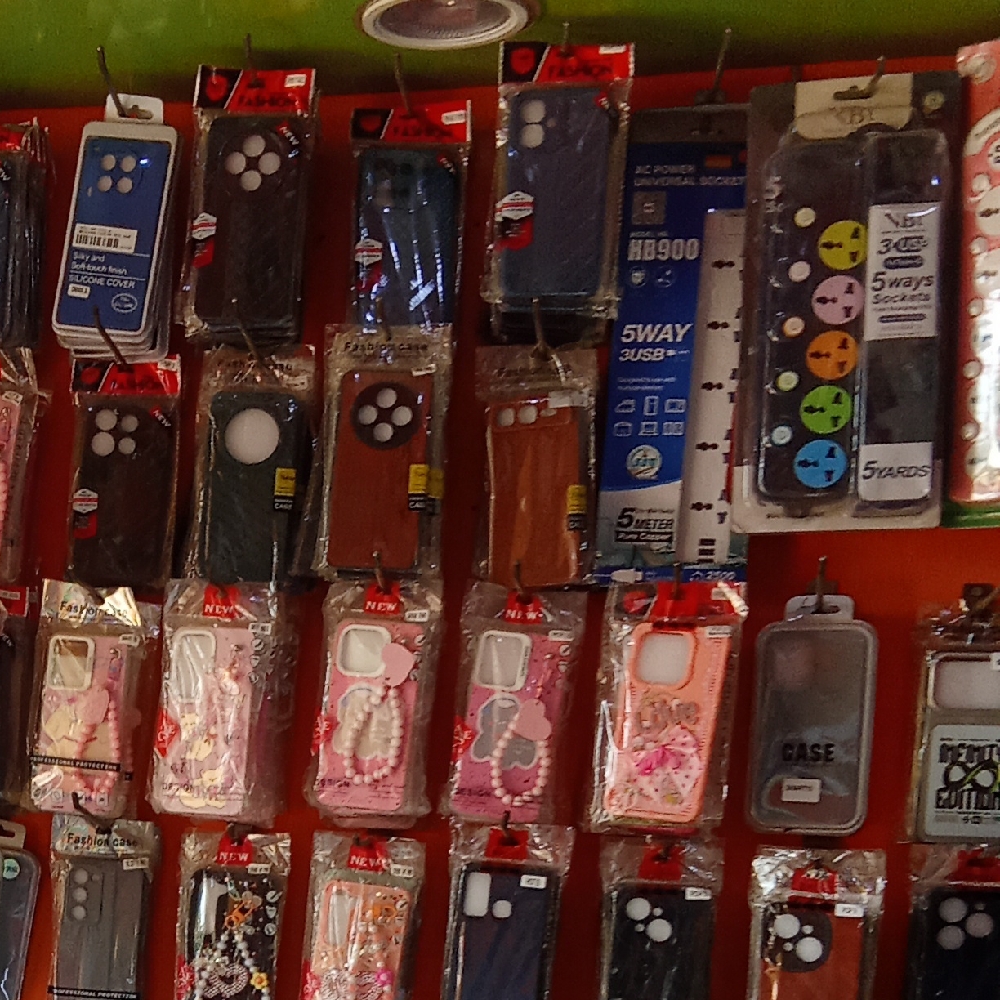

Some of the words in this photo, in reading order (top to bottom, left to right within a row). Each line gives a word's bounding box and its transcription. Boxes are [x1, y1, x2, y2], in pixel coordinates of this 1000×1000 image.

[106, 280, 136, 289] COVER
[621, 323, 694, 343] 5WAY
[617, 507, 636, 529] 5
[203, 603, 235, 615] NEW
[364, 601, 397, 612] NEW
[781, 742, 836, 763] CASE
[67, 832, 110, 849] Fashion
[218, 852, 250, 863] NEW
